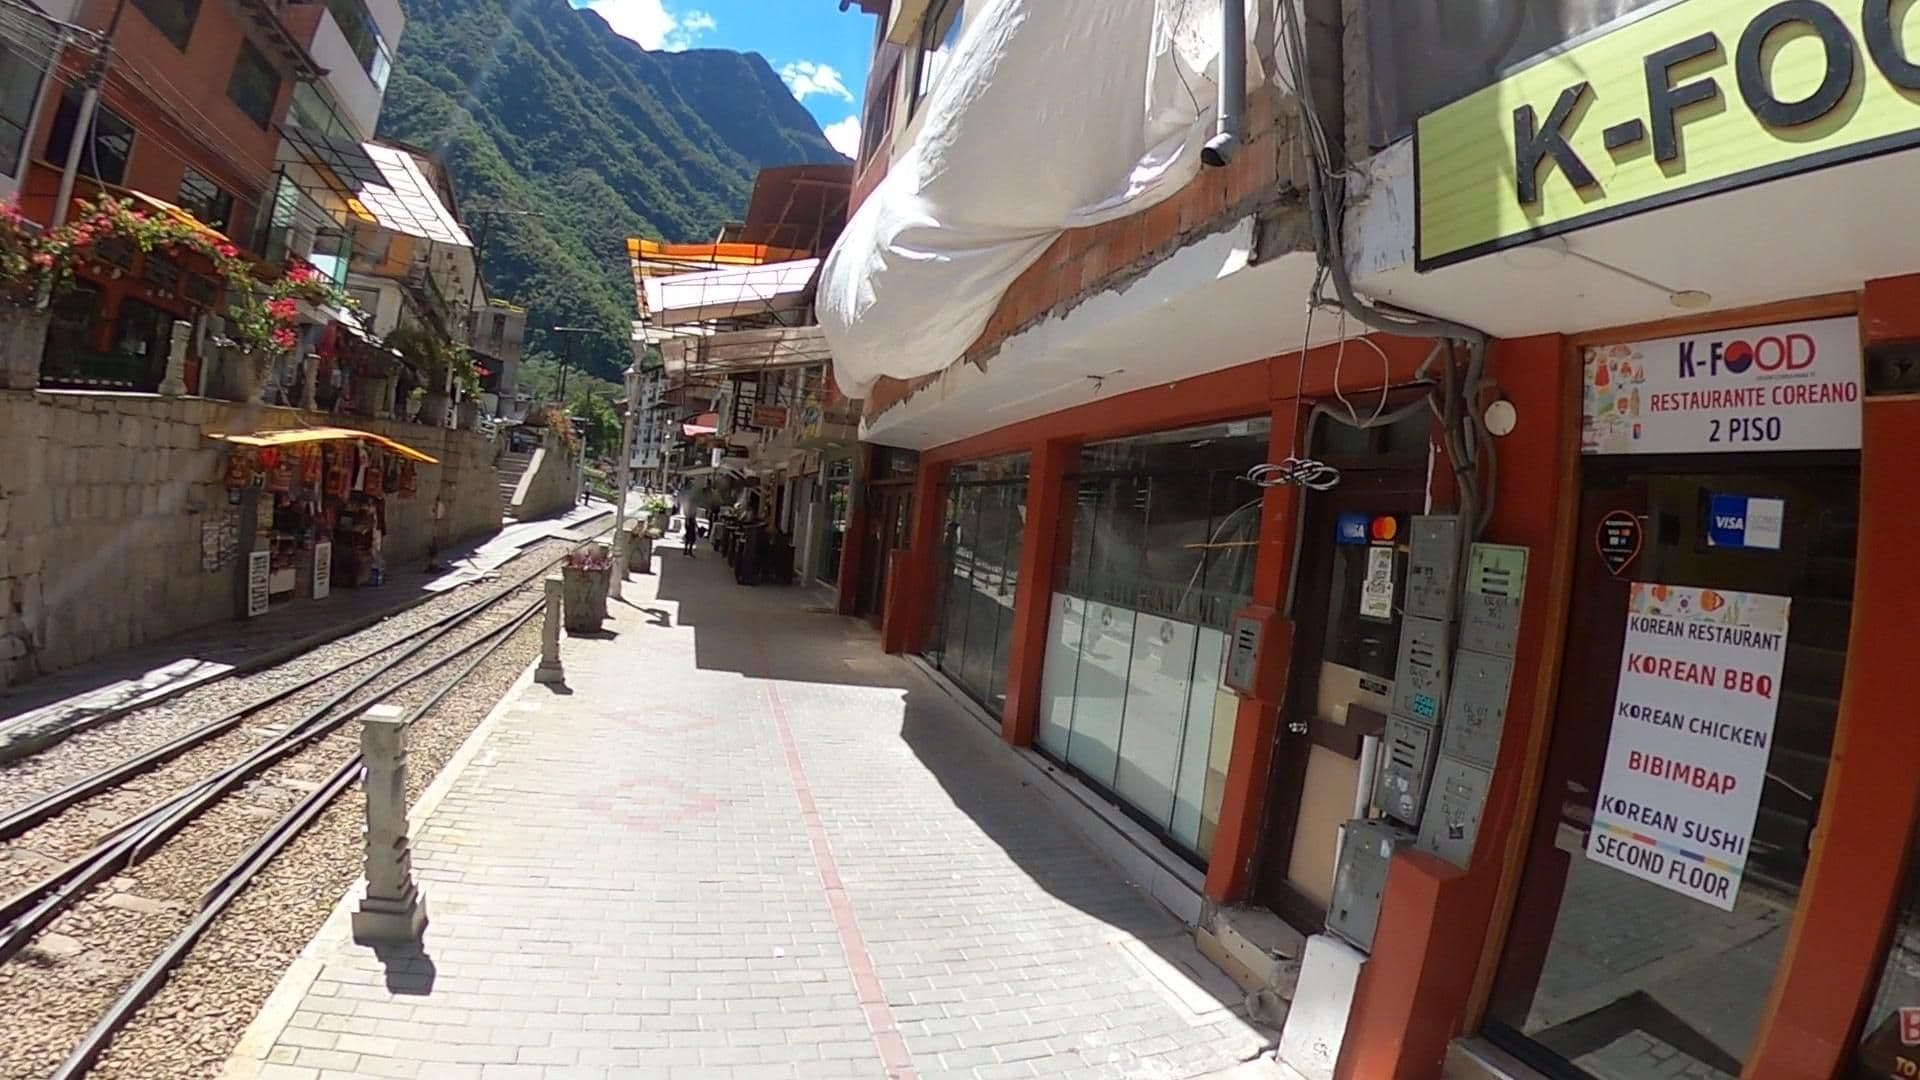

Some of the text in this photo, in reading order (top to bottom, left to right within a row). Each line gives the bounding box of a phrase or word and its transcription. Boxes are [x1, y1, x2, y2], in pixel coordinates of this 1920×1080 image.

[1650, 381, 1858, 412] RESTAURANTE COREANO
[1708, 416, 1782, 443] 2 PISO
[1715, 515, 1745, 531] VISA
[1629, 616, 1783, 652] KOREAN RESTAURANT
[1627, 653, 1773, 699] KOREAN BBQ
[1618, 701, 1768, 749] KOREAN CHICKEN
[1628, 750, 1737, 796] BIBIMBAP
[1601, 794, 1745, 856] KOREAN SUSHI
[1595, 834, 1730, 900] SECOND FLOOR
